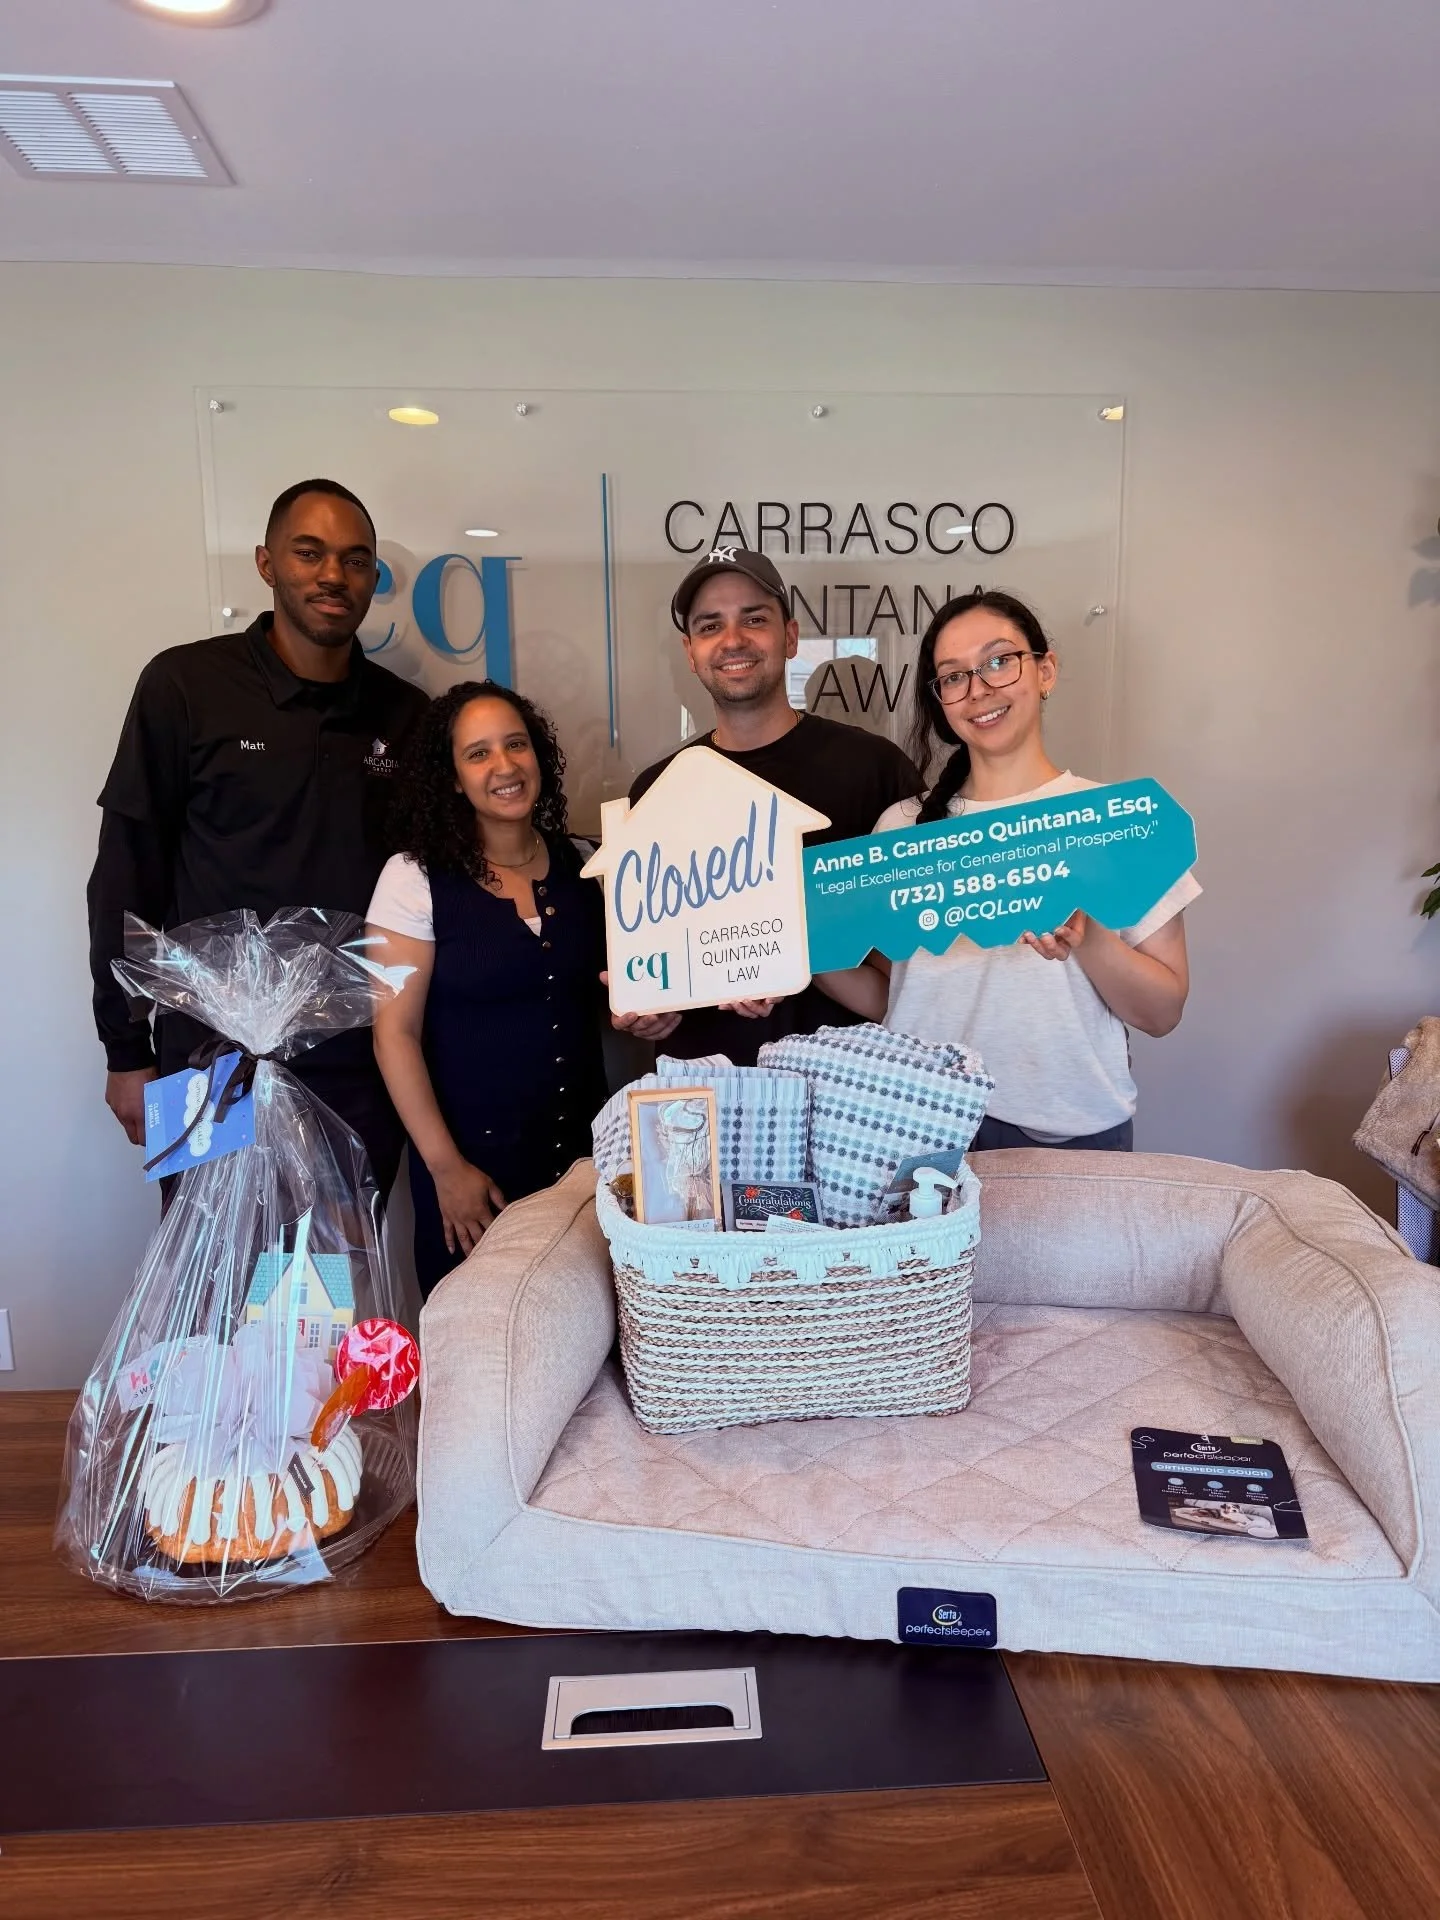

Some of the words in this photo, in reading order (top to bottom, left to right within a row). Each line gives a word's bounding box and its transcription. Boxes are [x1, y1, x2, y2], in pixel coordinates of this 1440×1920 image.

[665, 501, 1014, 555] CARRASCO
[809, 663, 909, 713] AW
[240, 739, 266, 751] Matt
[363, 756, 400, 769] ARCADIA
[812, 851, 864, 875] Anne
[868, 846, 889, 865] B.
[892, 829, 984, 859] Carrasco
[988, 805, 1102, 841] Quintana,
[1107, 795, 1159, 818] Esq.
[614, 791, 778, 933] Closed!
[815, 877, 857, 895] "Legal
[860, 863, 934, 887] Excellence
[937, 858, 956, 873] for
[960, 839, 1061, 869] Generational
[1065, 820, 1159, 850] Prosperity."
[889, 881, 945, 911] (732)
[952, 860, 1071, 897] 588-6504
[944, 895, 1044, 928] @CQLaw
[699, 918, 783, 945] CARRASCO
[701, 941, 782, 967] QUINTANA
[625, 952, 672, 991] cq
[727, 965, 760, 983] LAW
[738, 1194, 812, 1210] Congratulations
[1156, 1464, 1224, 1475] ORTHOPEDIC
[1227, 1468, 1268, 1478] COUCH
[938, 1609, 957, 1620] Serta
[905, 1624, 986, 1638] perfectsleeper
